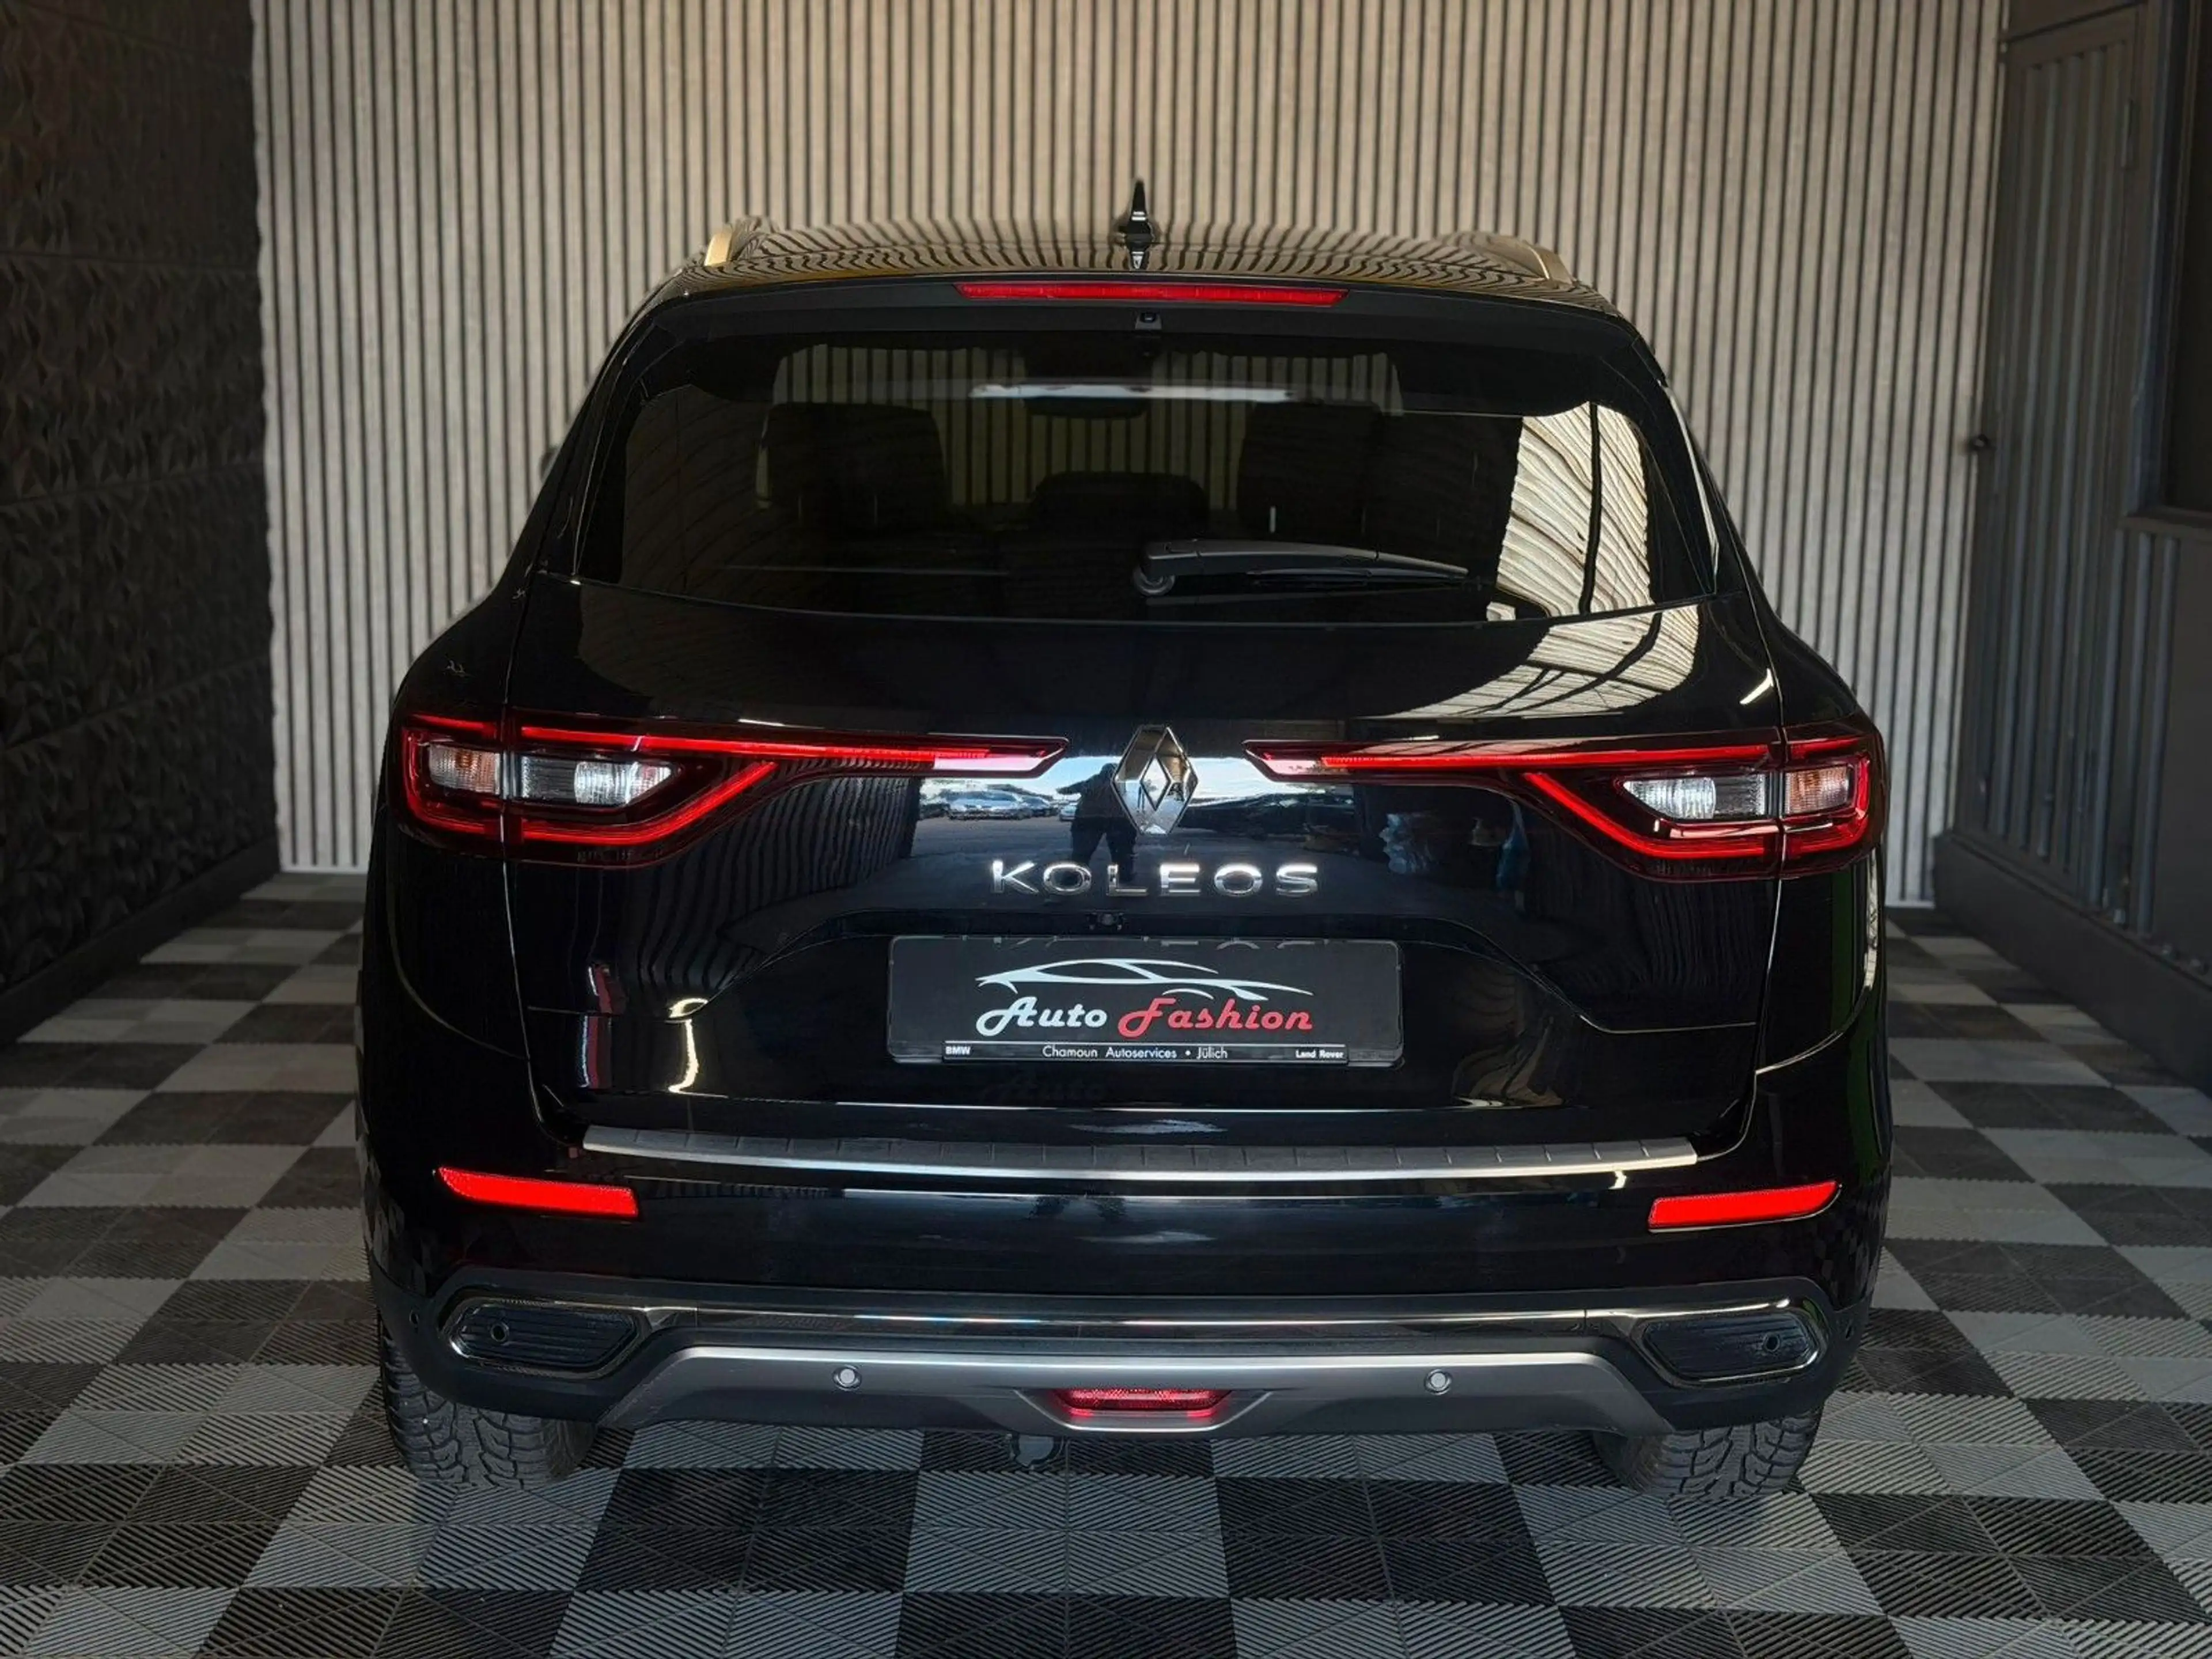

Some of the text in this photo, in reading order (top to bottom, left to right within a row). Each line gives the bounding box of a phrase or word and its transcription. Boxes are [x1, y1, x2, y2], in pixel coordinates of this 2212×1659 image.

[991, 859, 1319, 897] KOLEOS
[976, 997, 1313, 1038] Auto Fashion
[945, 1046, 971, 1055] BMW
[1042, 1045, 1228, 1060] Chamoun Autoservices Jülich
[1296, 1049, 1344, 1059] Land Rover
